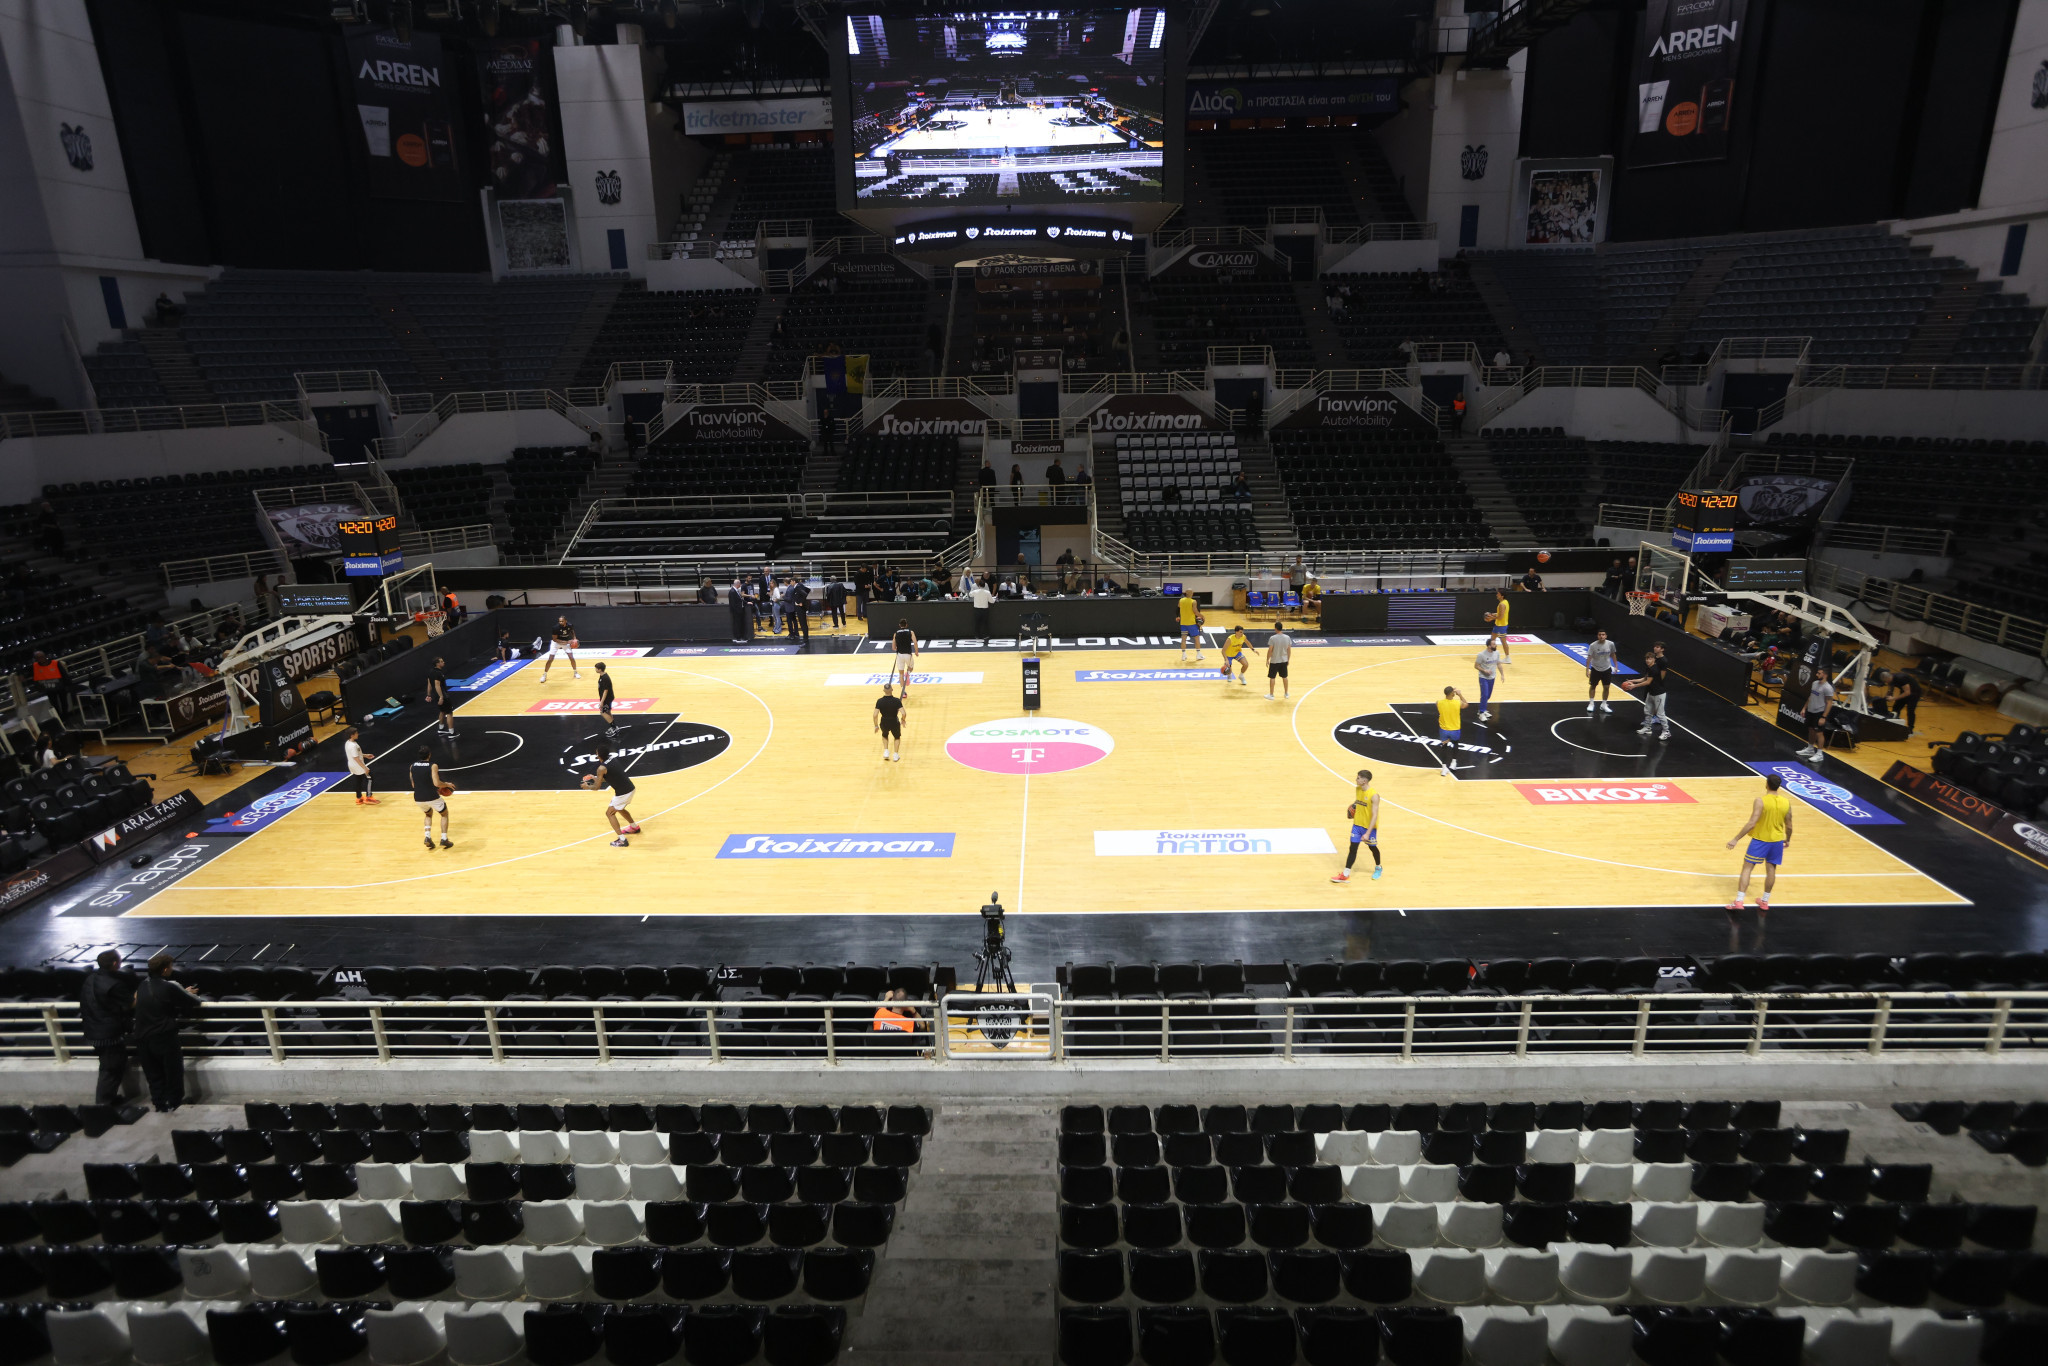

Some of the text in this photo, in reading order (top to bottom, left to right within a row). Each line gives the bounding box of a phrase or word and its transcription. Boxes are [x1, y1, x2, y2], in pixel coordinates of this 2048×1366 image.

[1649, 20, 1738, 58] ARREN
[359, 59, 440, 87] ARREN
[1189, 90, 1234, 114] Διός
[1256, 96, 1306, 107] ΠΡΟΣΤΑΣΙΑ
[1308, 95, 1328, 105] είναι
[1330, 96, 1346, 105] στη
[1376, 94, 1391, 102] του
[1643, 95, 1662, 104] ARREN
[686, 108, 807, 128] ticketmaster
[918, 231, 957, 241] Stoiximan
[983, 227, 1037, 236] Stoiximan
[1064, 227, 1107, 238] Stoiximan
[831, 262, 895, 273] Tselementes
[995, 264, 1076, 275] PAOK SPORTS ARENA
[1317, 397, 1398, 414] Γιαννίρης
[689, 409, 767, 427] Γιαννίρης
[878, 414, 985, 436] Stoiximan
[1091, 409, 1202, 431] Stoiximan
[1321, 415, 1393, 428] AutoMobility
[695, 426, 764, 440] AutoMobility
[1013, 443, 1061, 453] Stoiximan
[1701, 495, 1738, 508] 42:20
[339, 521, 373, 534] 42:20
[375, 516, 397, 531] 42:20
[1695, 537, 1732, 545] Stoiximan
[345, 561, 378, 569] Stoiximan
[283, 636, 337, 678] SPORTS
[1084, 670, 1221, 680] Stoiximan
[278, 725, 310, 747] Stoiximan
[969, 728, 1090, 737] COSMOTE
[1929, 780, 1995, 817] MILON
[122, 811, 155, 834] ARAL
[154, 794, 187, 816] FARM
[1156, 831, 1247, 840] Stoiximan
[730, 836, 935, 854] Stoiximan
[89, 843, 210, 908] snappi
